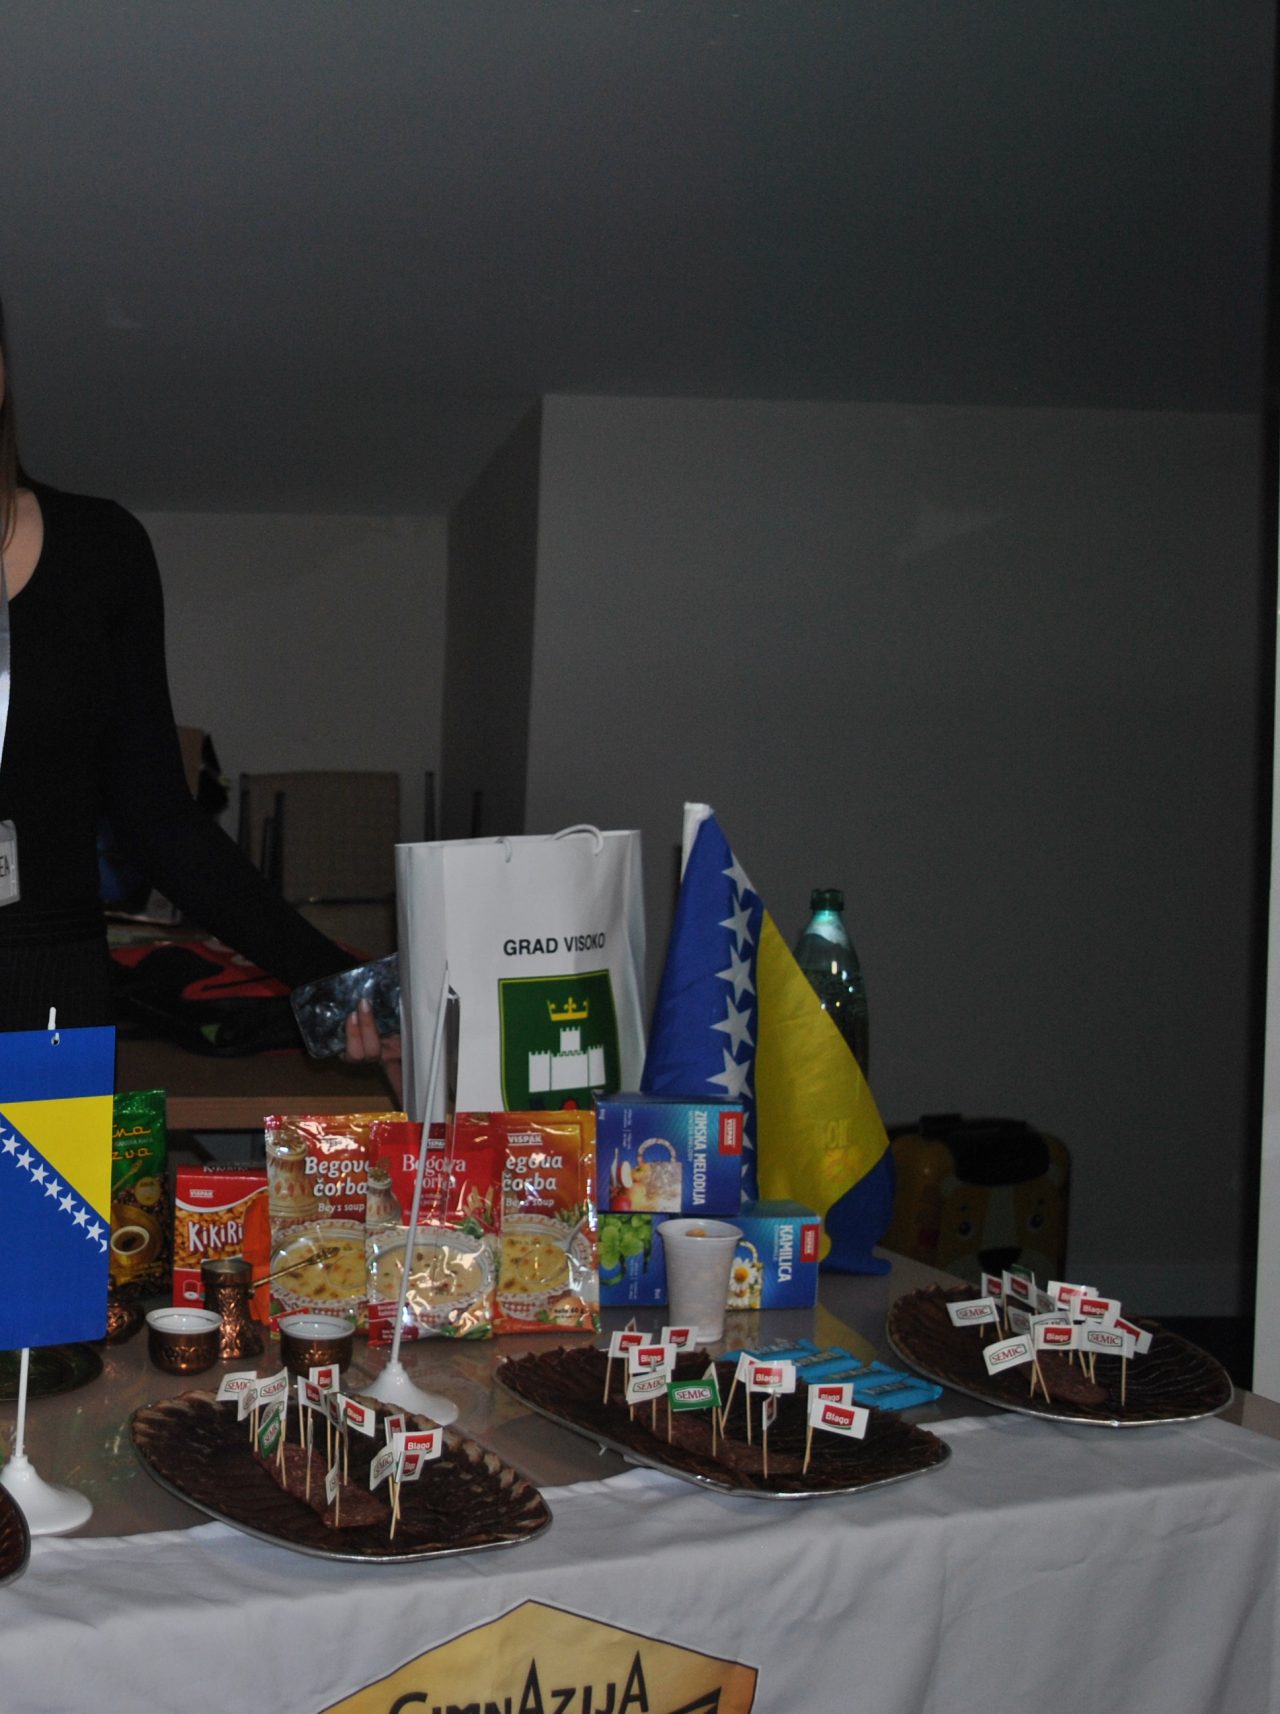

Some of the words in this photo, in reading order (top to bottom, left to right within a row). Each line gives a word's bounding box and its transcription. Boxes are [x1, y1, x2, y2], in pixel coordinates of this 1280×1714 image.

[503, 937, 558, 956] GRAD
[563, 932, 606, 951] VISOKO
[507, 1134, 542, 1144] VISPAK
[693, 1110, 708, 1150] ZIMSKA
[506, 1155, 563, 1174] egova
[692, 1153, 707, 1206] MELODIJA
[344, 1203, 365, 1213] soup
[188, 1220, 243, 1252] KiKiRi
[777, 1224, 794, 1283] KAMILICA
[389, 1650, 649, 1714] AZIJA
